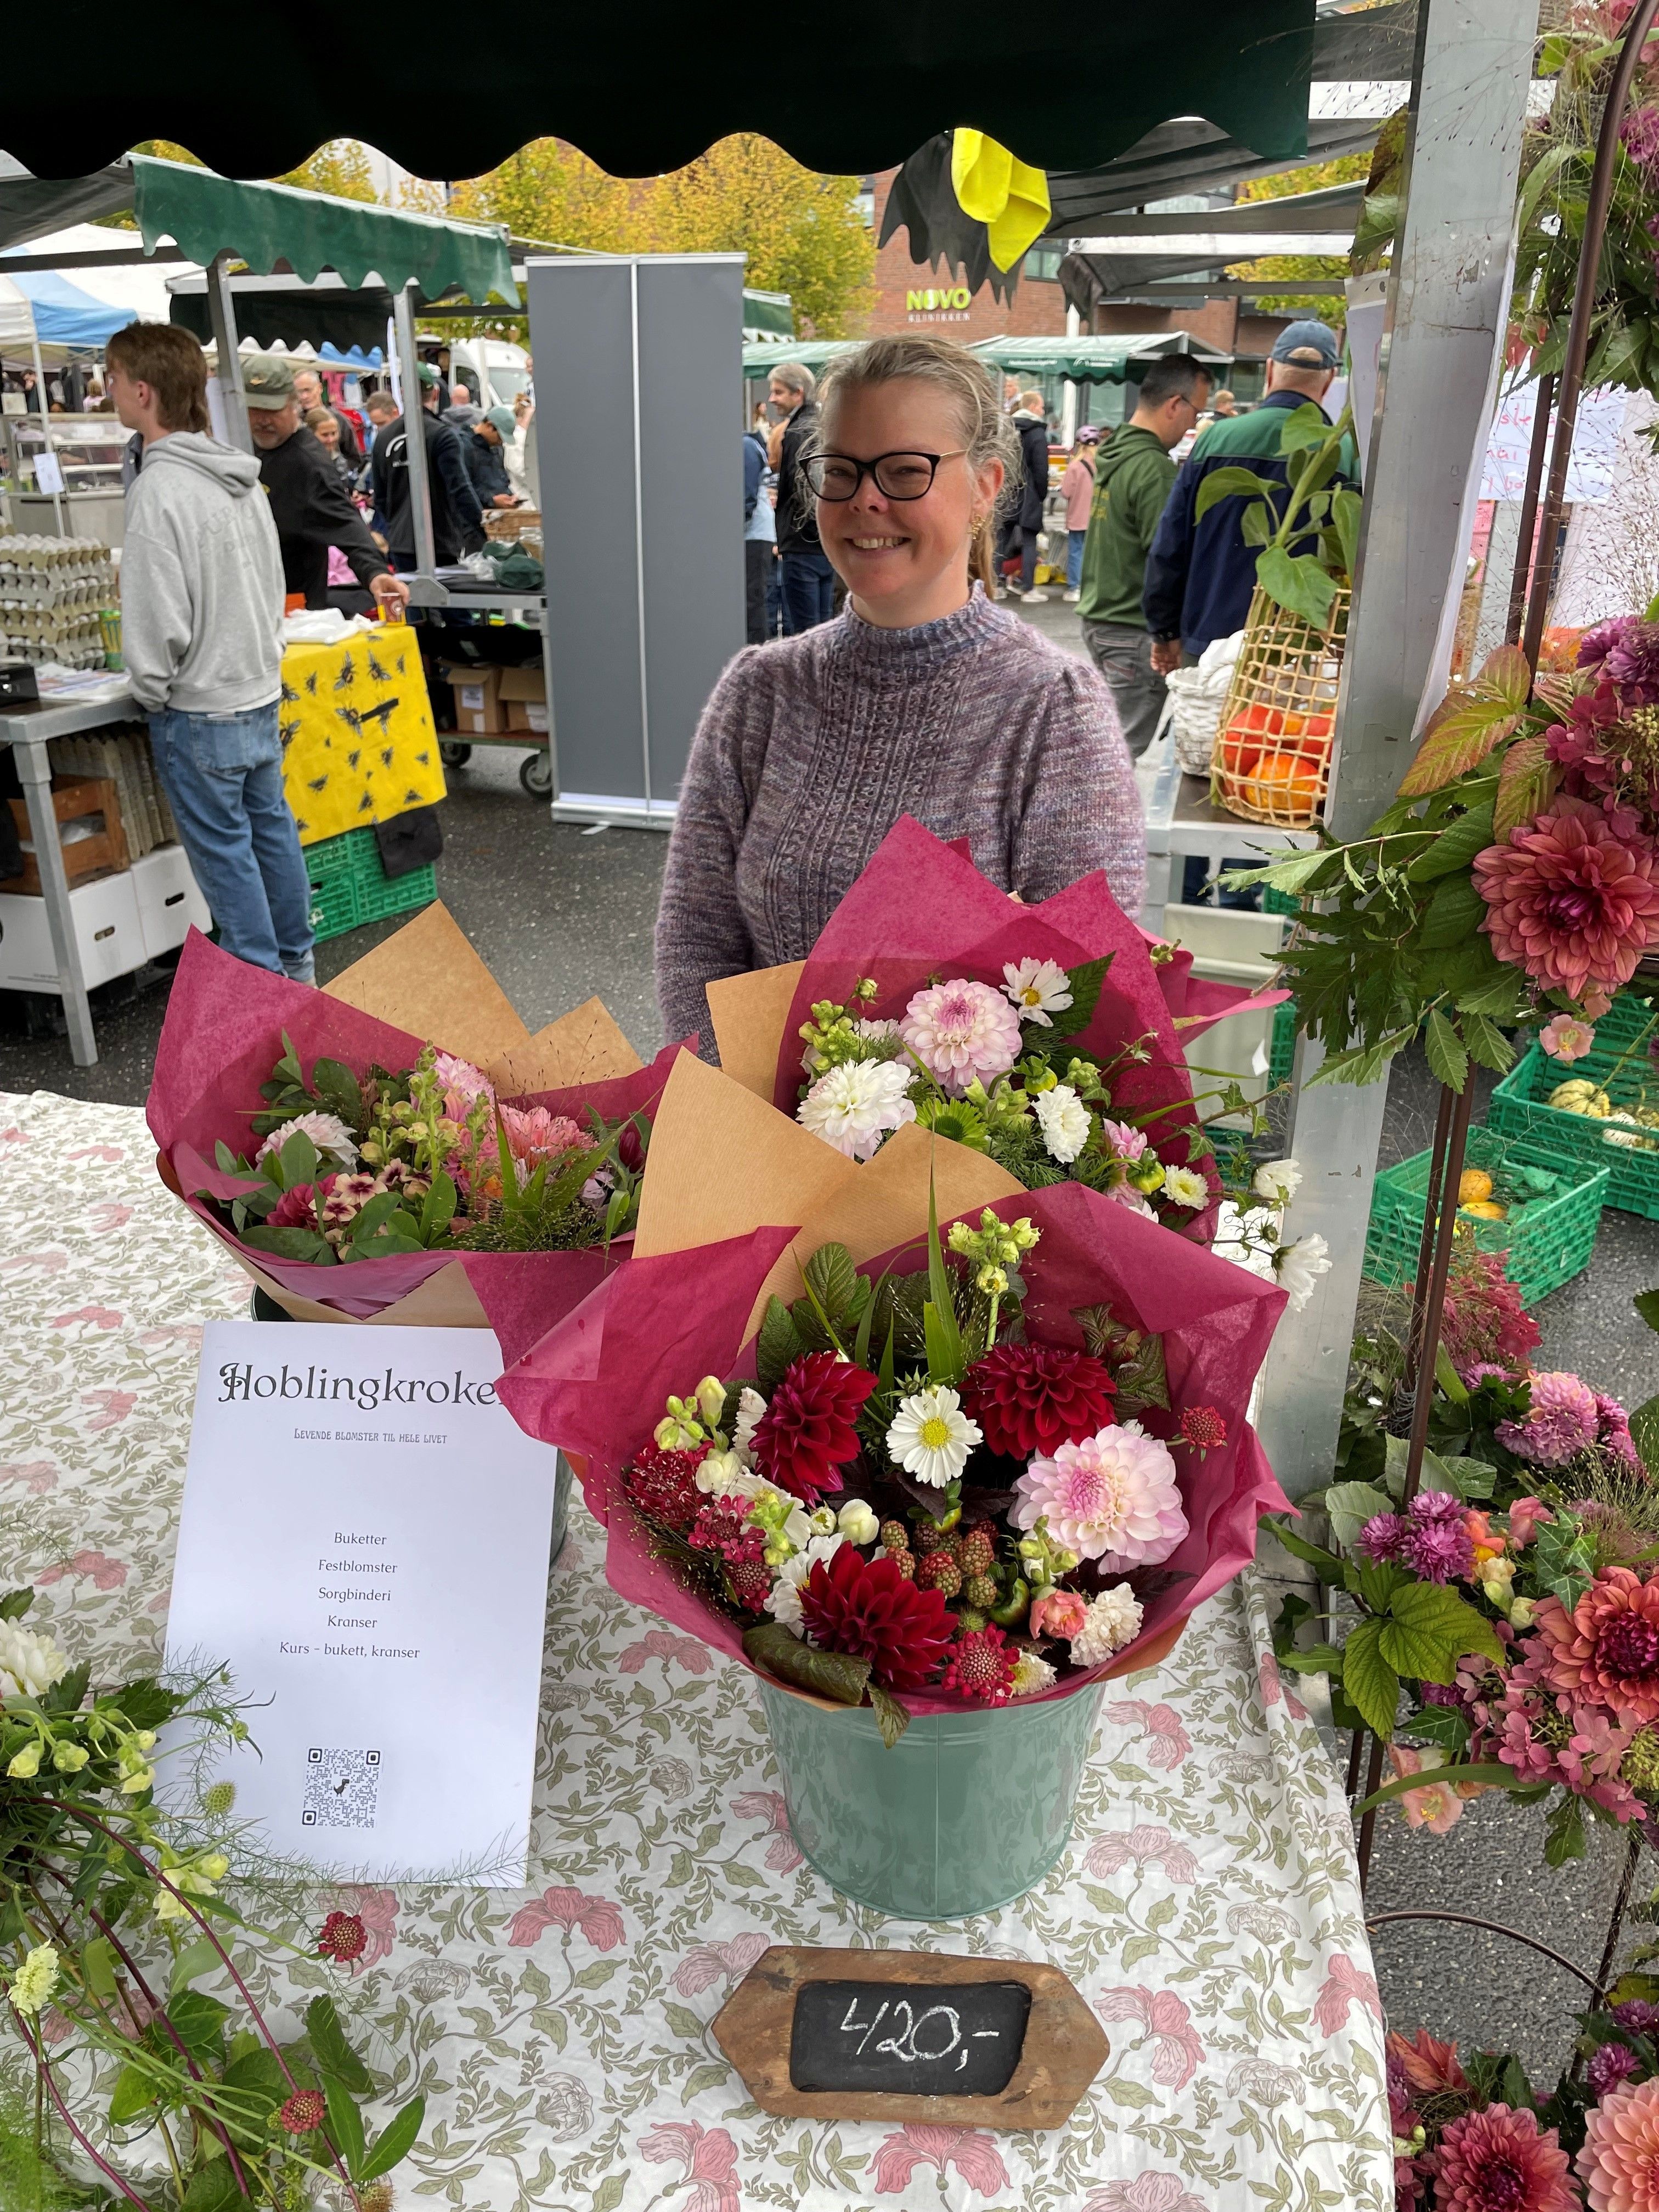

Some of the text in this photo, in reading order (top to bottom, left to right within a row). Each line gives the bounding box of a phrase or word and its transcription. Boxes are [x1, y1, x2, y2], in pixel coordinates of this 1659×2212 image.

[906, 287, 972, 311] NOVO
[217, 1362, 504, 1410] Hoblingkroke
[335, 1431, 379, 1441] BLOMSTER
[382, 1433, 396, 1442] TIL
[399, 1434, 420, 1443] HELE
[424, 1434, 448, 1443] LIVET
[334, 1532, 387, 1545] Buketter
[318, 1559, 398, 1575] Festblomster
[318, 1587, 391, 1604] Sorgbinderi
[327, 1615, 378, 1628] Kranser
[279, 1641, 310, 1654] Kurs
[324, 1643, 368, 1658] bukett,
[371, 1645, 420, 1659] kranser
[840, 1997, 1000, 2072] 420,-
